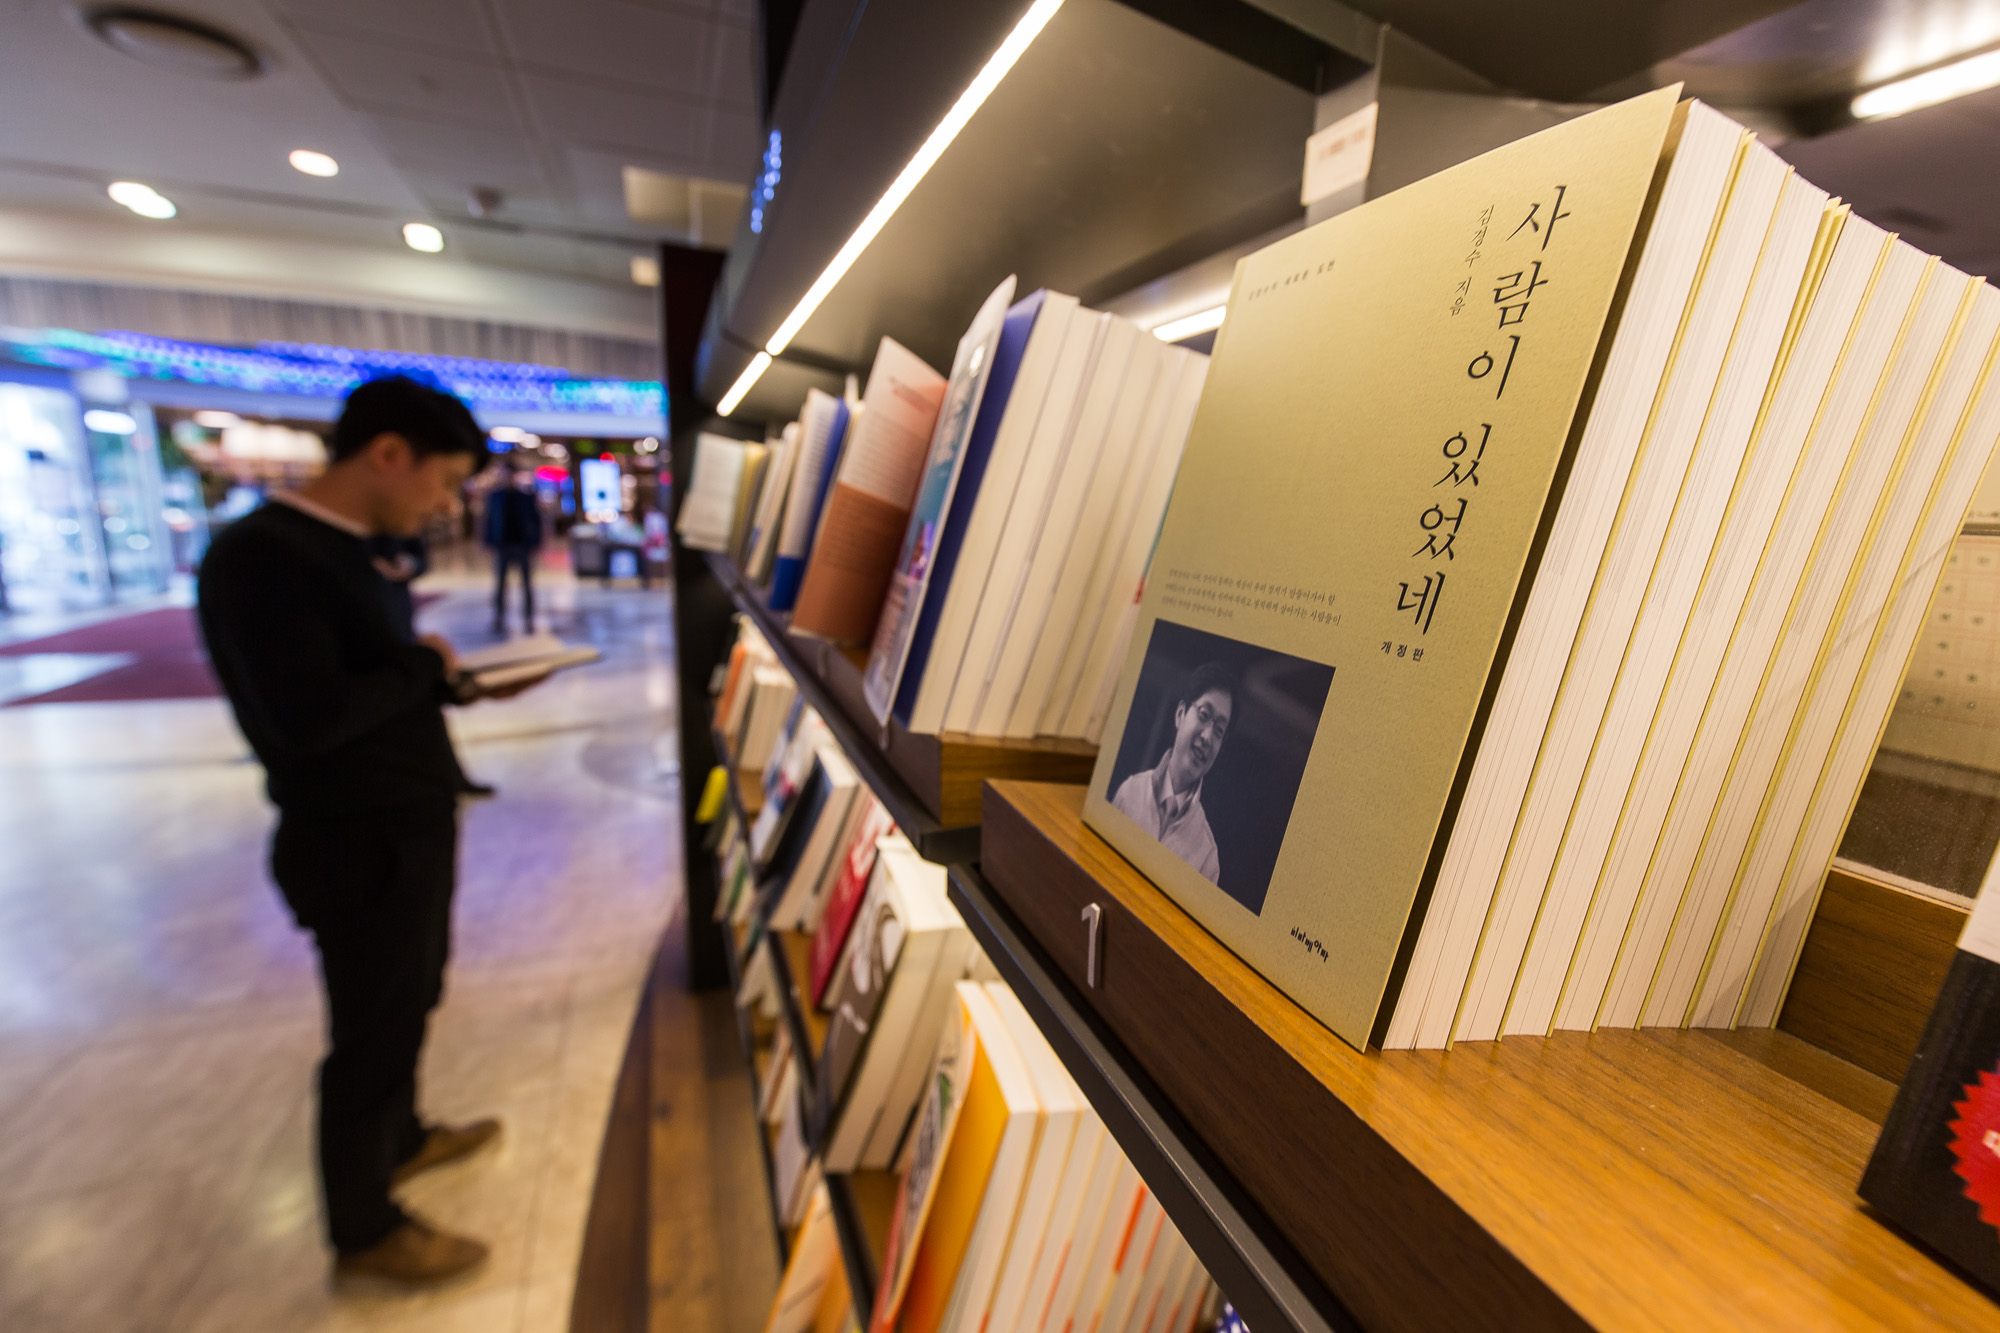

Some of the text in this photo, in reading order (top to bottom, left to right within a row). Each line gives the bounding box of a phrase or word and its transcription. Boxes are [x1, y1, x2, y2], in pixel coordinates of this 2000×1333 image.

[1464, 204, 1495, 268] 김경수
[1397, 185, 1571, 636] 사람이 있었네
[1380, 641, 1424, 662] 개정판
[1081, 902, 1101, 989] 1
